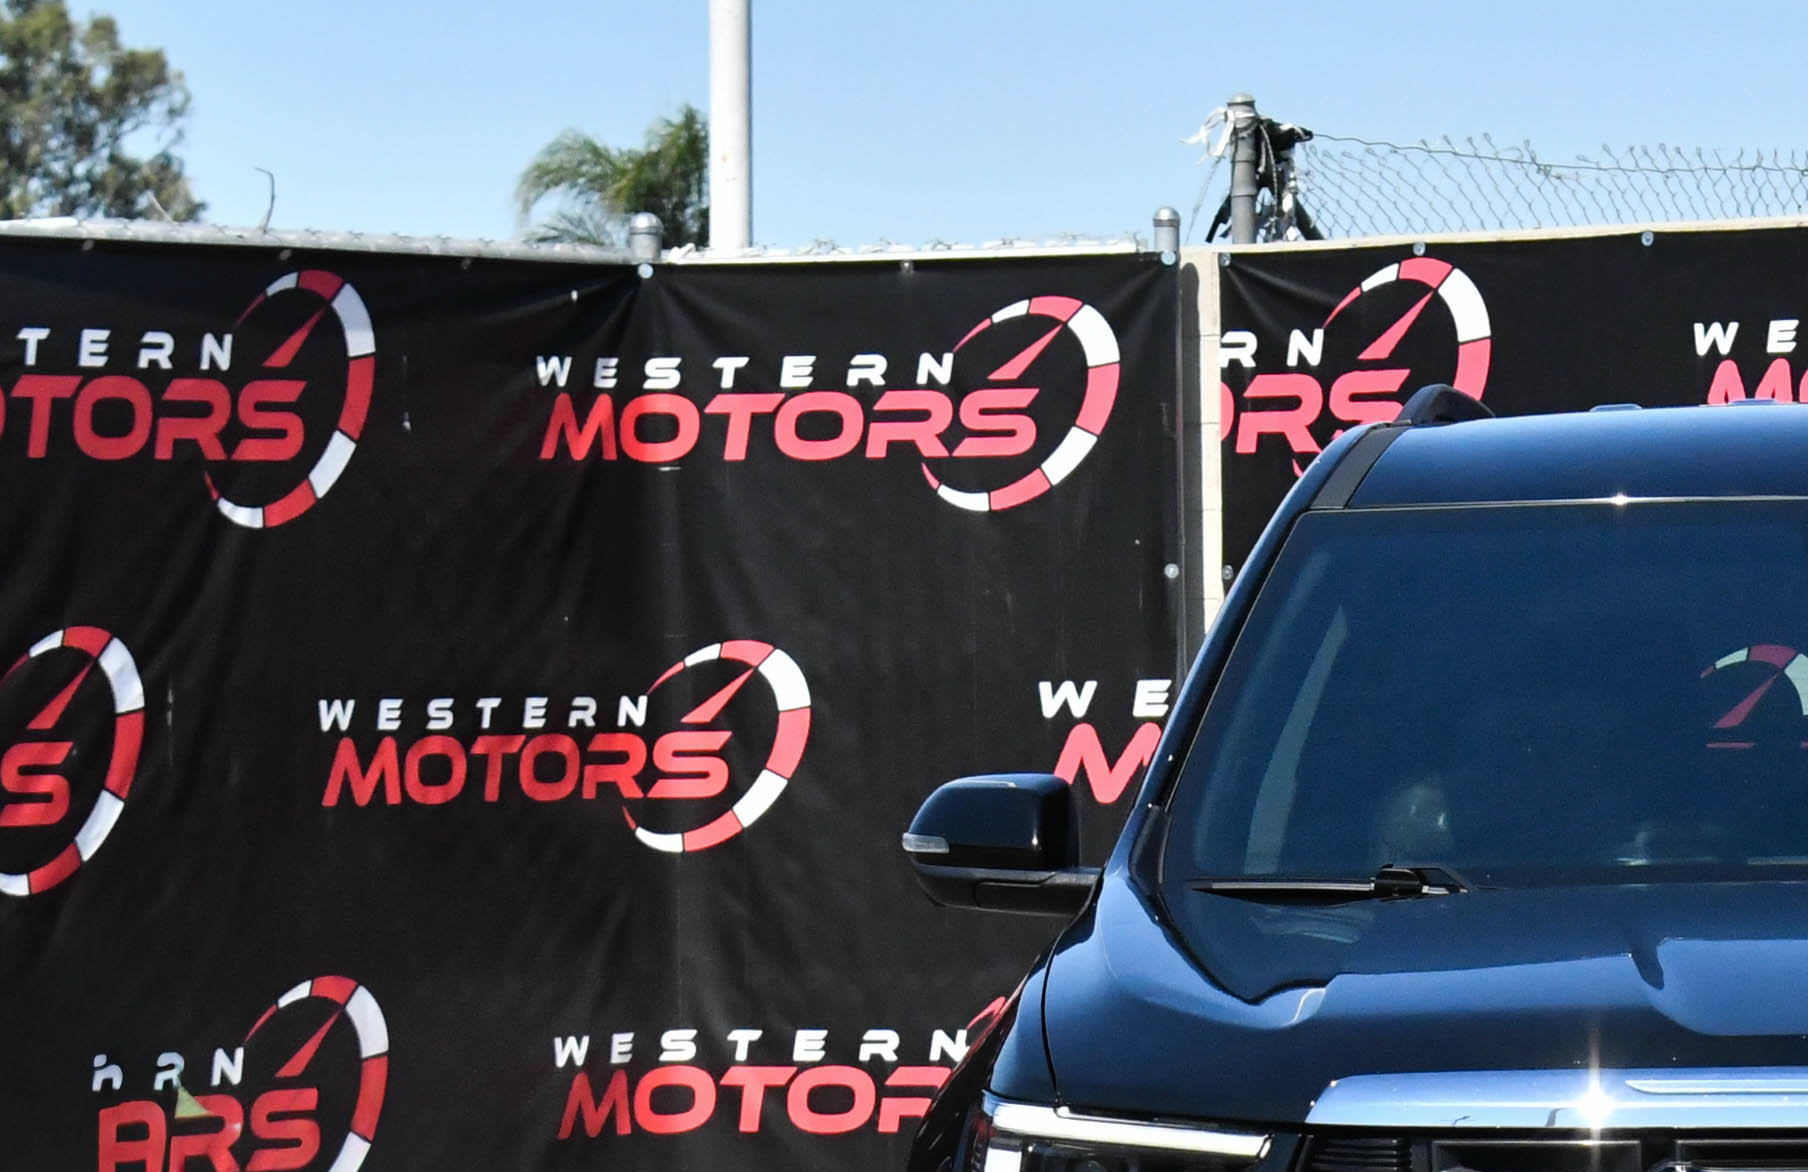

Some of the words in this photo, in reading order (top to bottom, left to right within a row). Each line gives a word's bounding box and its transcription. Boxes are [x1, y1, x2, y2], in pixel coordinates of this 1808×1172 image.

[536, 352, 954, 389] WESTERN
[0, 375, 307, 461] TORS
[540, 388, 1039, 461] MOTORS
[1221, 368, 1410, 454] RS
[318, 696, 647, 731] WESTERN
[1039, 679, 1173, 718] WE
[322, 729, 732, 807] MOTORS
[553, 1029, 968, 1068] WESTERN
